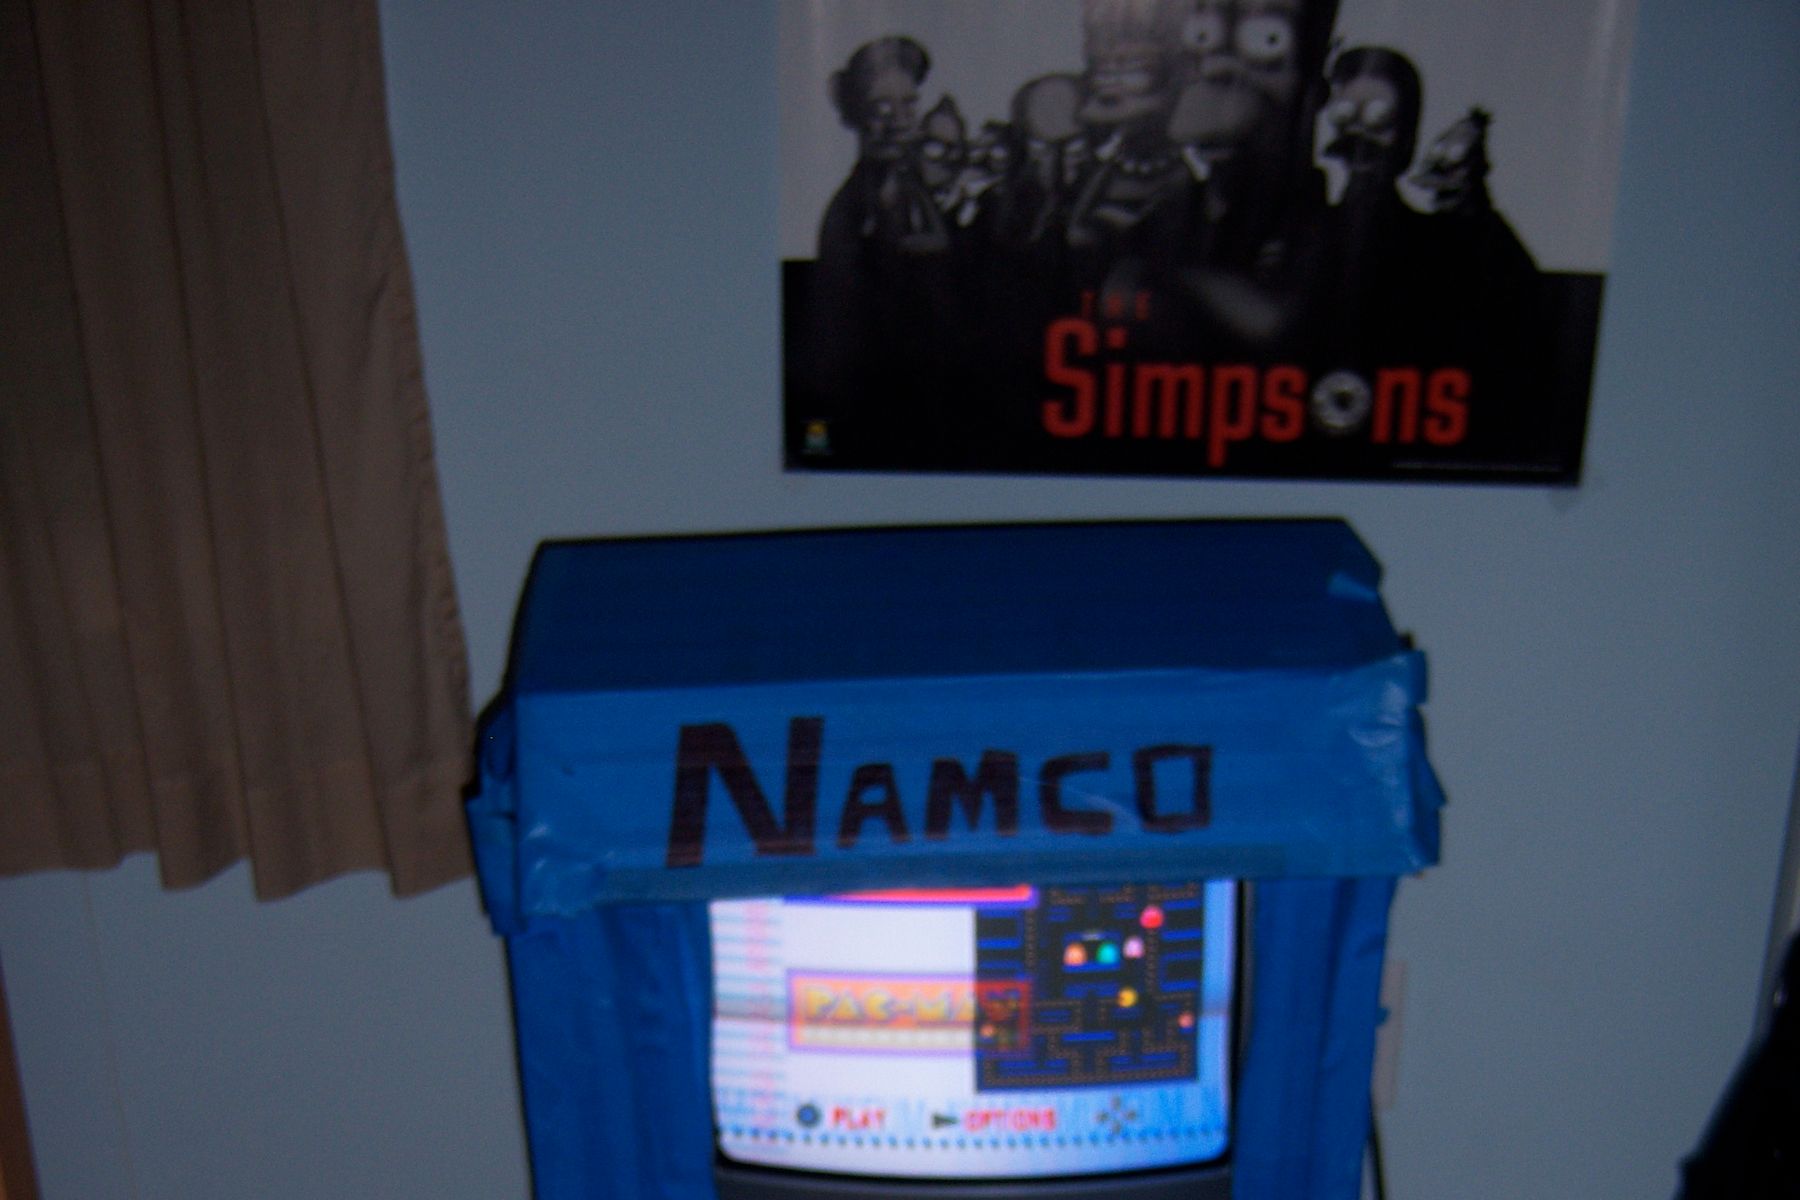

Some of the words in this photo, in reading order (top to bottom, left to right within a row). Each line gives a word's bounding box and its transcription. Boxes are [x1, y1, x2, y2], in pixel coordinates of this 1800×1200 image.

[1041, 315, 1474, 469] Simpsons
[666, 715, 1213, 868] NAMCO
[802, 986, 1018, 1023] PAC-MA
[831, 1106, 886, 1132] PLAY
[963, 1106, 1057, 1132] OPTIONS
